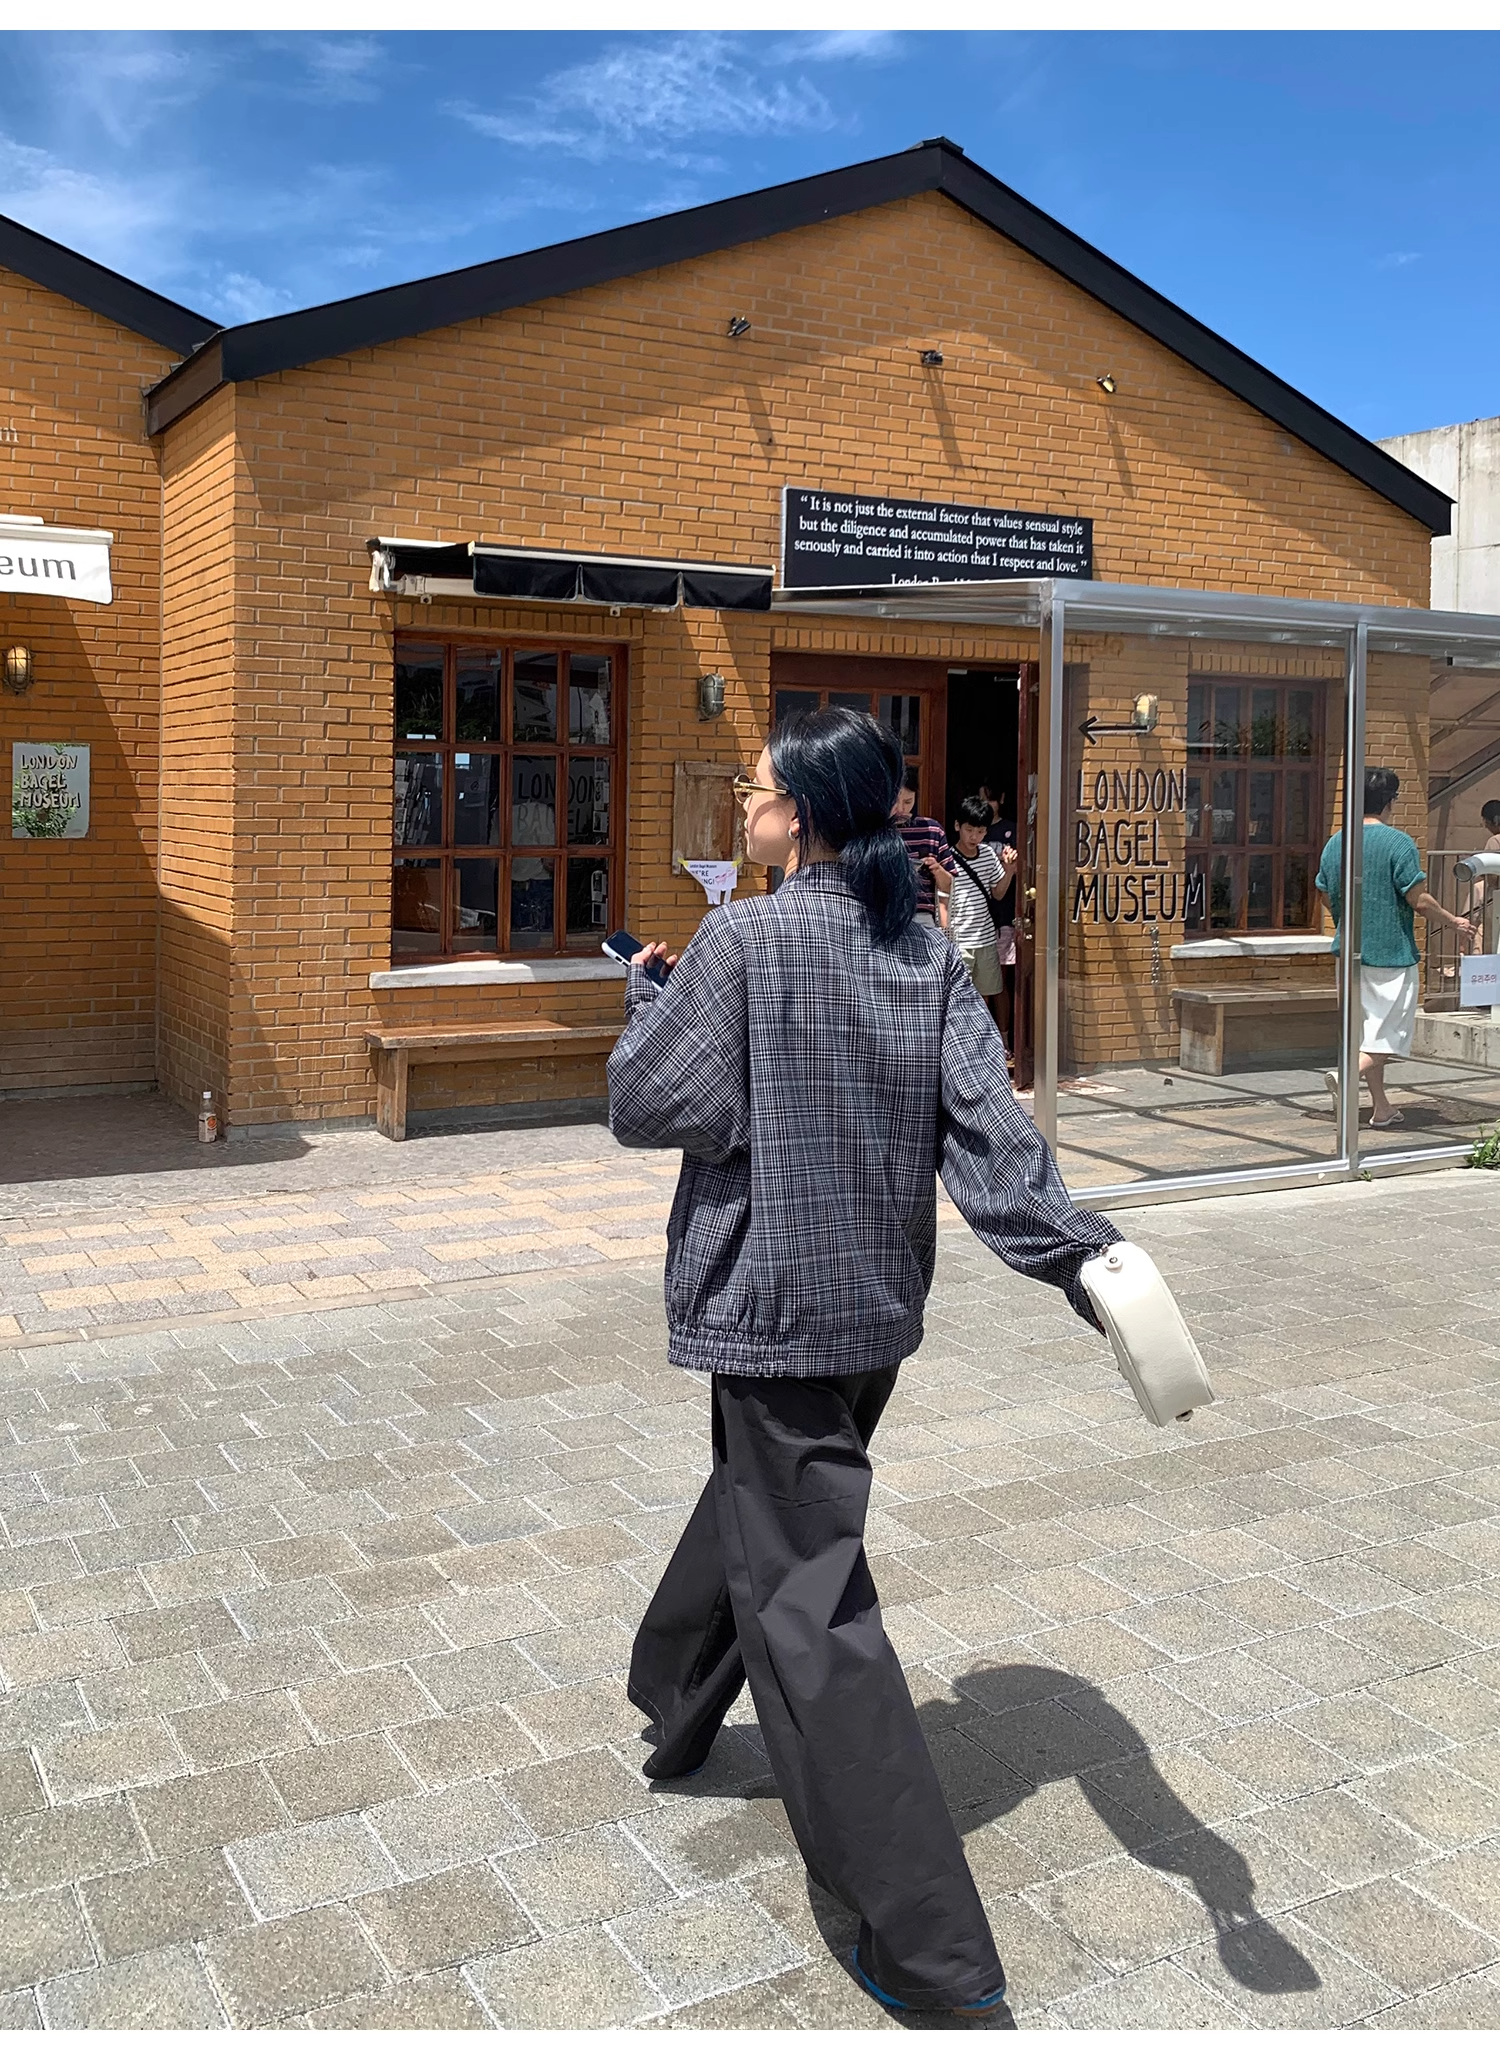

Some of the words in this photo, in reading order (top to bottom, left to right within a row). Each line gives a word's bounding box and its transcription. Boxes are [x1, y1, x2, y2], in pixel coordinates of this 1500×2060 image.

[799, 515, 818, 532] but
[821, 517, 838, 533] the
[840, 520, 887, 540] diligence
[889, 525, 909, 540] and
[911, 528, 973, 545] accumulated
[976, 535, 1006, 549] power
[1008, 536, 1028, 550] that
[1030, 536, 1046, 551] has
[1049, 540, 1074, 554] taken
[1076, 541, 1084, 555] it
[810, 496, 820, 511] It
[822, 498, 832, 512] is
[834, 502, 852, 514] not
[855, 500, 874, 518] just
[877, 502, 894, 518] the
[896, 507, 937, 522] external
[940, 508, 970, 525] factor
[972, 512, 991, 527] that
[993, 514, 1023, 530] values
[1025, 520, 1060, 534] sensual
[1062, 522, 1084, 538] style
[794, 538, 841, 558] seriously
[843, 541, 863, 555] and
[866, 544, 902, 559] carried
[904, 546, 912, 560] it
[914, 546, 935, 562] into
[937, 550, 968, 564] action
[970, 551, 990, 566] that
[992, 553, 997, 566] I
[1000, 556, 1035, 572] respect
[1036, 558, 1054, 571] and
[1056, 558, 1079, 573] love.
[20, 773, 68, 790] BAGEL
[21, 754, 78, 770] LONDON
[20, 792, 81, 809] MUSEUM
[1075, 768, 1187, 815] LONDON
[1075, 818, 1171, 870] BAGEL
[1072, 873, 1206, 924] MUSEUM
